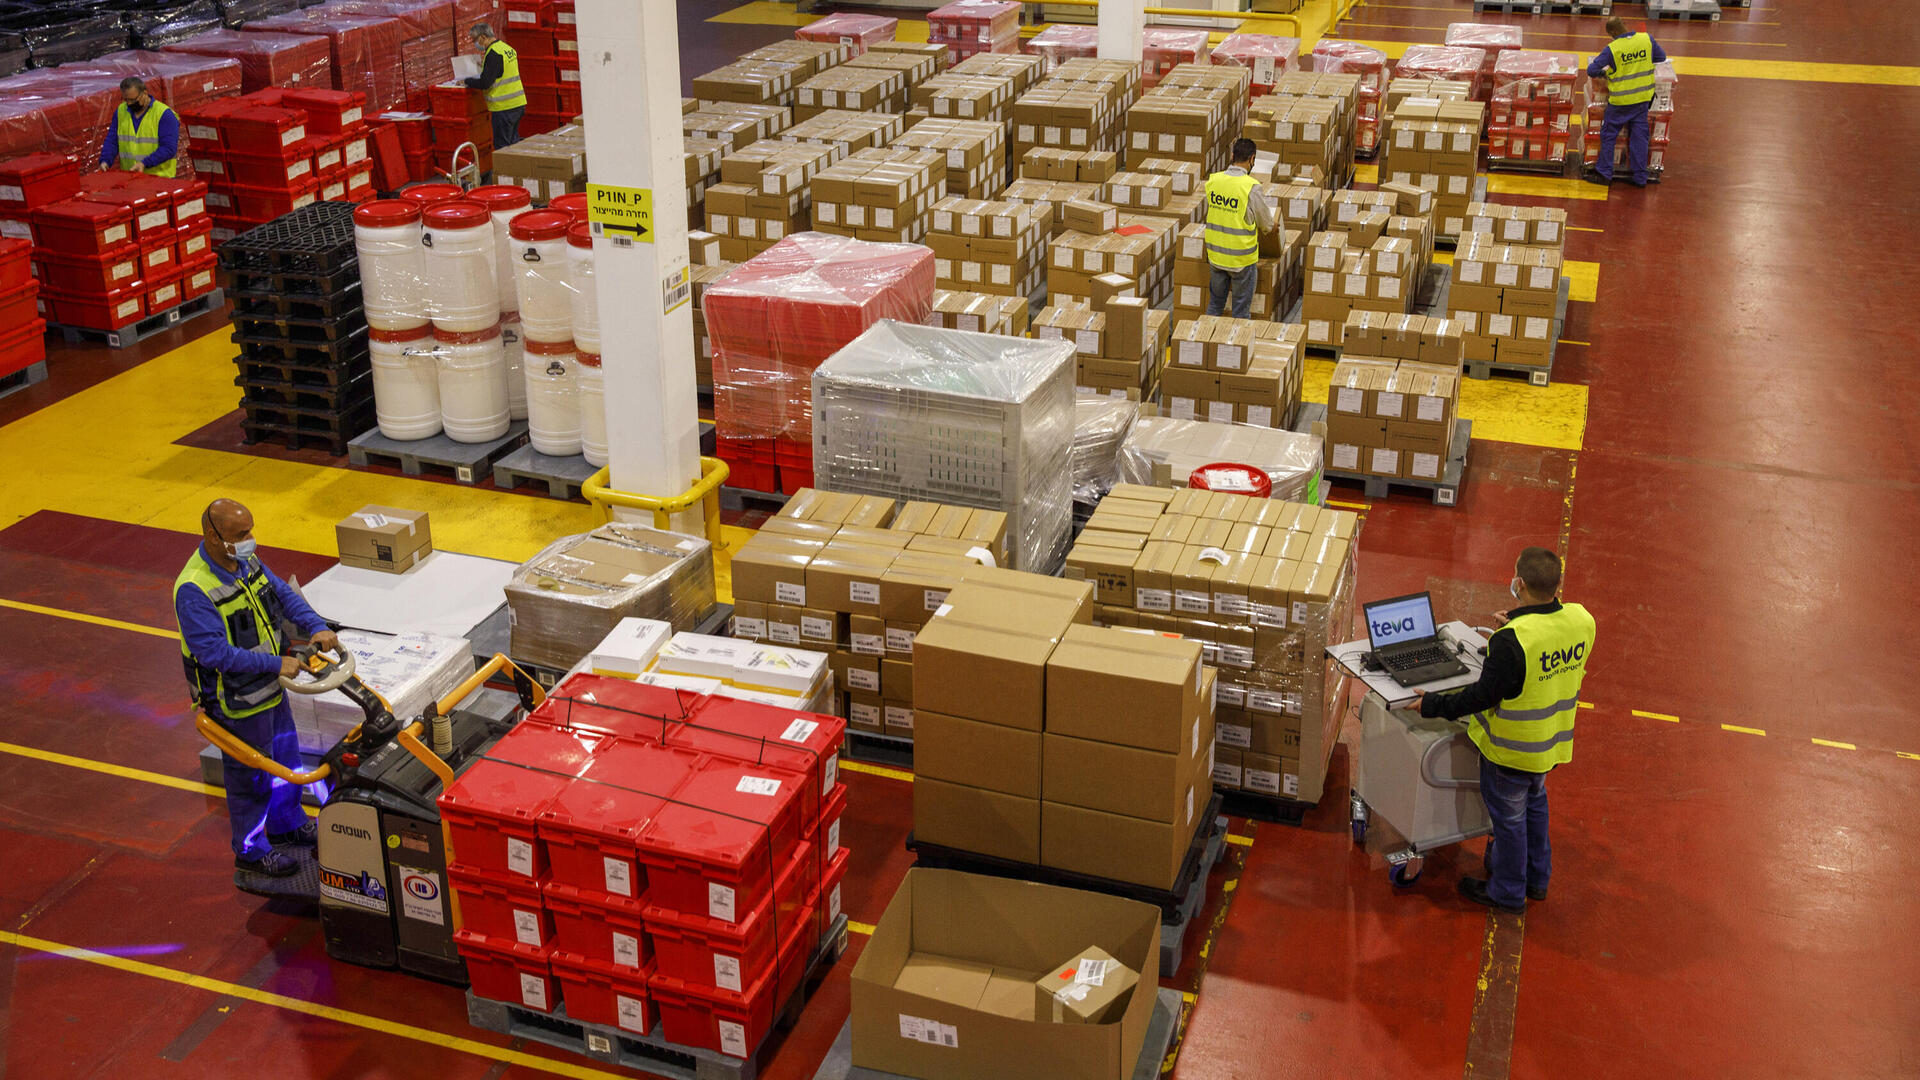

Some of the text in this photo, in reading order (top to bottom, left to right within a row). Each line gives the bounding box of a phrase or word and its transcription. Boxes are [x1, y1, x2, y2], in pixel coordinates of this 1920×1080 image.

[1621, 49, 1646, 62] teva
[597, 190, 642, 207] P1IN_P
[1210, 191, 1239, 209] teva
[593, 206, 648, 219] חזרה מהייצור
[1372, 617, 1415, 638] teva
[1539, 641, 1585, 673] teva
[319, 870, 344, 889] UM
